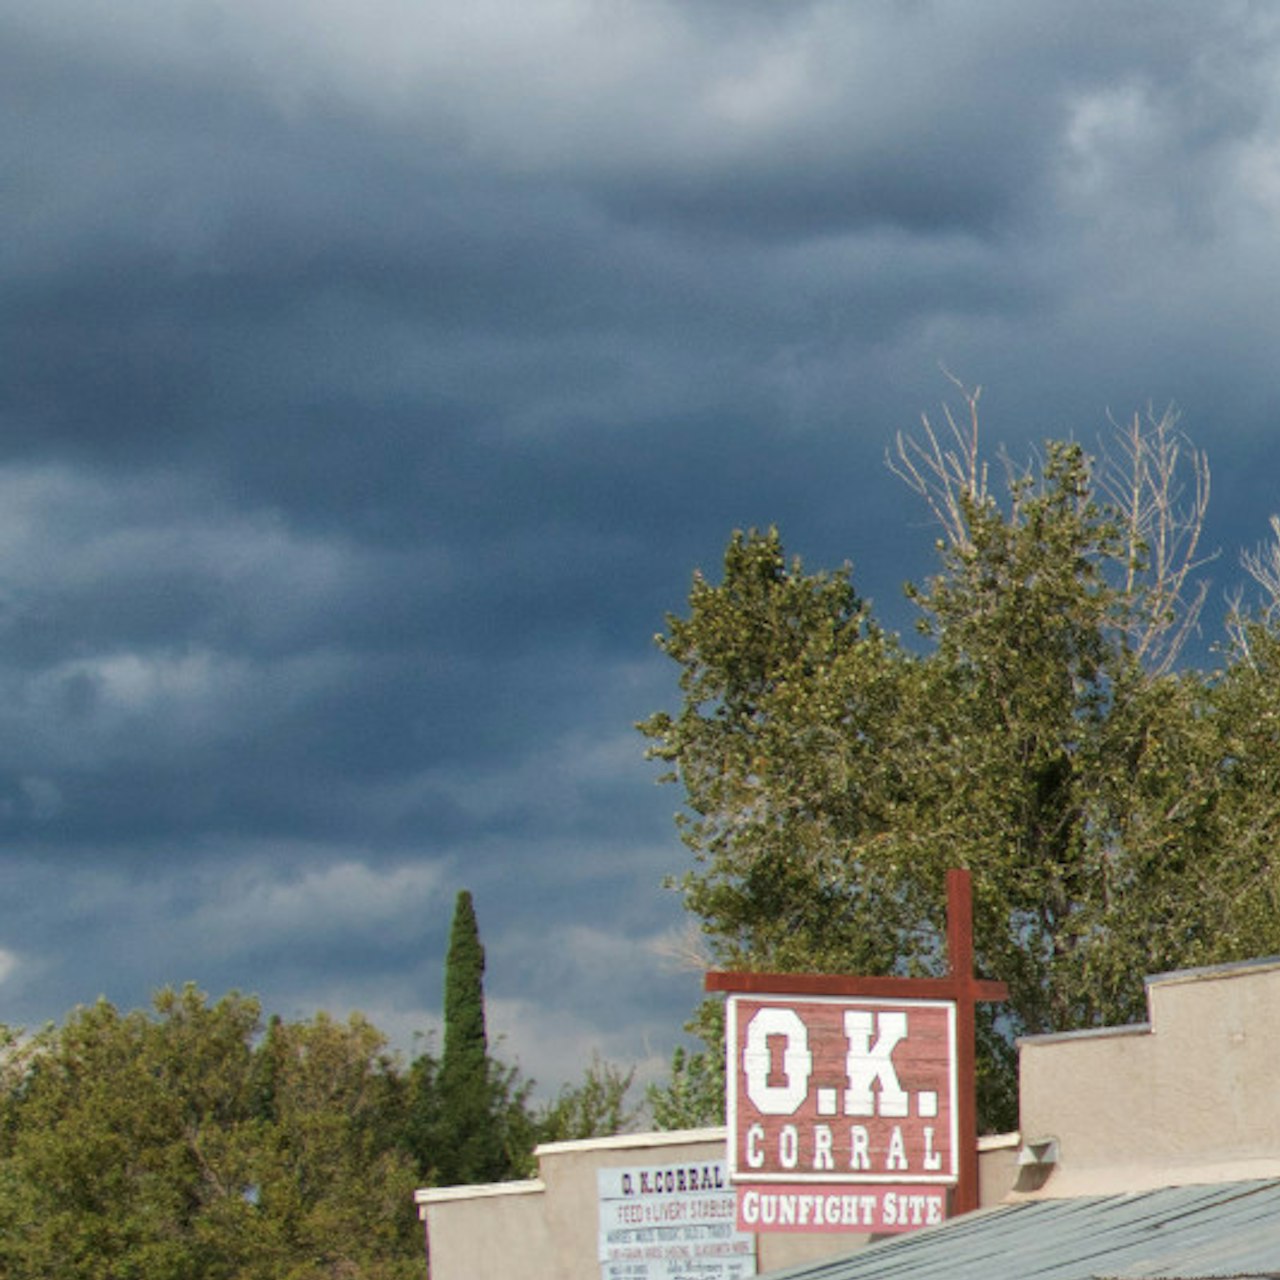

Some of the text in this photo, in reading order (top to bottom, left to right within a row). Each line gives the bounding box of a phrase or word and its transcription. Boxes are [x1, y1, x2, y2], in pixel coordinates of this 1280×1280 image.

[743, 1006, 938, 1118] O.K.
[745, 1121, 942, 1171] CORRAL
[743, 1190, 942, 1227] GUNFIGHT SITE
